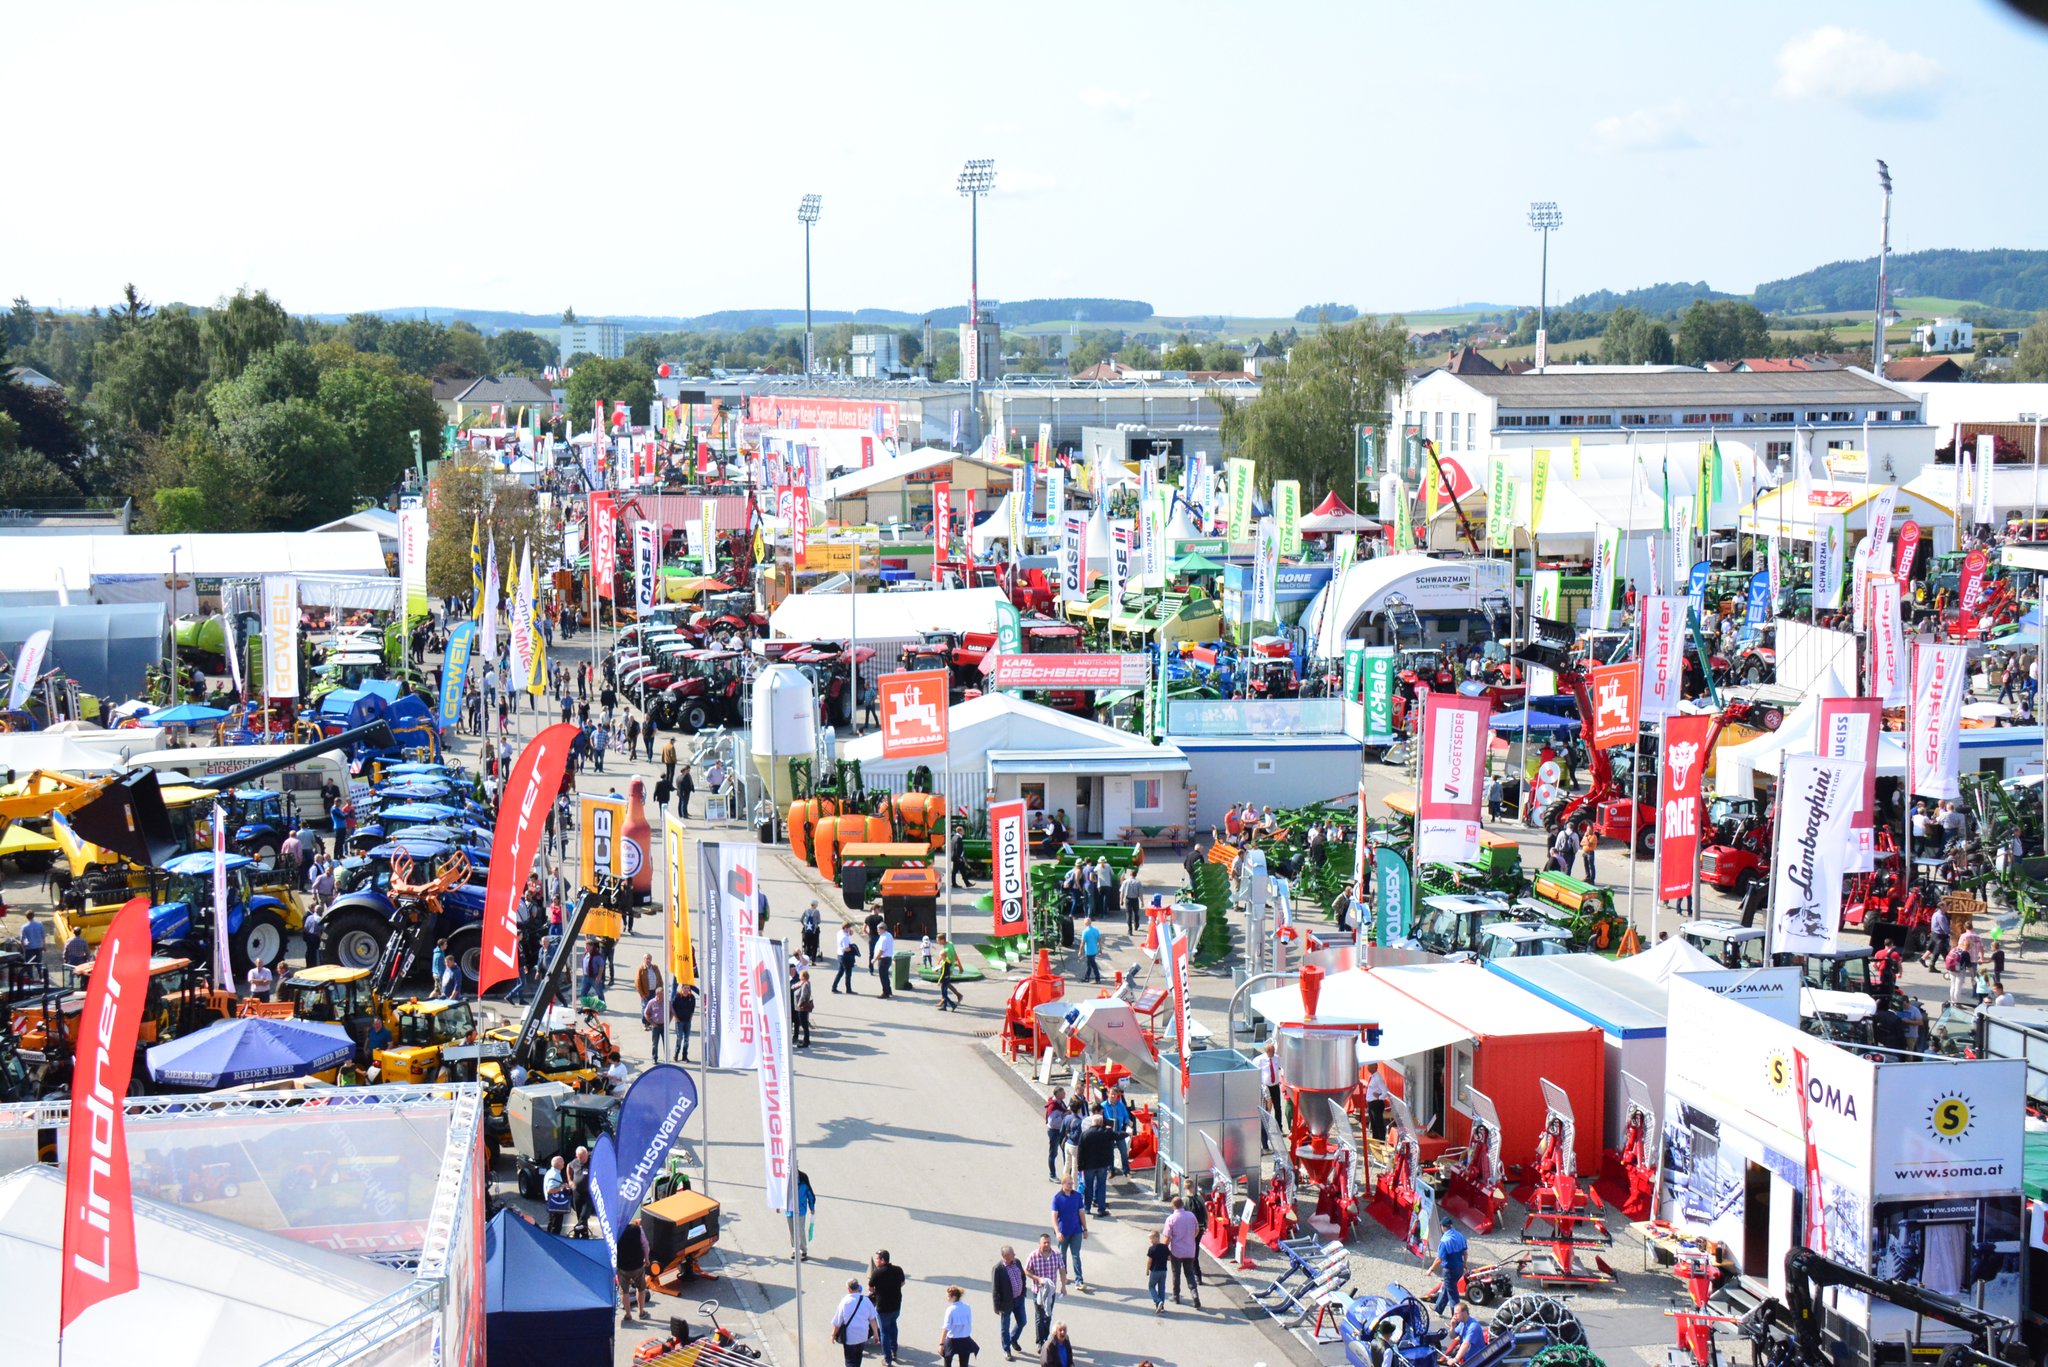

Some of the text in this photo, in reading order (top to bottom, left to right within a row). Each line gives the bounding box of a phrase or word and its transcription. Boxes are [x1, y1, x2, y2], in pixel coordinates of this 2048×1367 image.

[801, 406, 817, 422] Keine
[817, 406, 838, 428] Sorgen
[839, 408, 857, 426] Arena
[1048, 477, 1056, 510] BAUER
[1235, 465, 1247, 523] KRONE
[1494, 460, 1504, 516] KRONE
[795, 495, 804, 556] STEYR
[937, 491, 948, 551] STEYR
[1285, 485, 1294, 537] KRONE
[1067, 538, 1078, 591] CASE
[1184, 542, 1223, 555] Regent
[1819, 531, 1828, 594] SCHWARZMAYR
[1897, 541, 1918, 582] KERBL
[640, 547, 652, 605] CASE
[1277, 573, 1312, 583] RONE
[1415, 576, 1471, 584] SCHWARZMAY
[1562, 588, 1592, 596] KRON
[1961, 572, 1984, 612] KERBL
[1654, 600, 1670, 702] Schäffer
[1882, 589, 1895, 686] Schäffer
[1000, 667, 1120, 679] DESCHBERGER
[1002, 659, 1035, 667] KARL
[1370, 659, 1387, 733] McHale
[1926, 651, 1945, 775] Schäffer
[1451, 712, 1465, 784] VOGETSEDER
[1827, 768, 1842, 810] TRATTORI
[1664, 797, 1695, 840] SAME
[1788, 766, 1834, 902] Lamborghini
[1004, 820, 1021, 895] Gruber
[1949, 899, 1982, 912] ENDT
[401, 953, 416, 979] JCB
[524, 1018, 541, 1046] JCB
[164, 1070, 212, 1082] RIEDER BIER
[233, 1064, 295, 1080] RIEDER BIER
[312, 1047, 351, 1069] RIEDER BIER
[1773, 1059, 1784, 1084] S
[75, 938, 120, 1283] Lindner
[1808, 1077, 1858, 1122] OMA
[1942, 1104, 1960, 1131] S
[632, 1095, 692, 1185] Husqvarna
[1894, 1163, 2005, 1181] www.soma.at
[1922, 1204, 1978, 1215] www.soma.a
